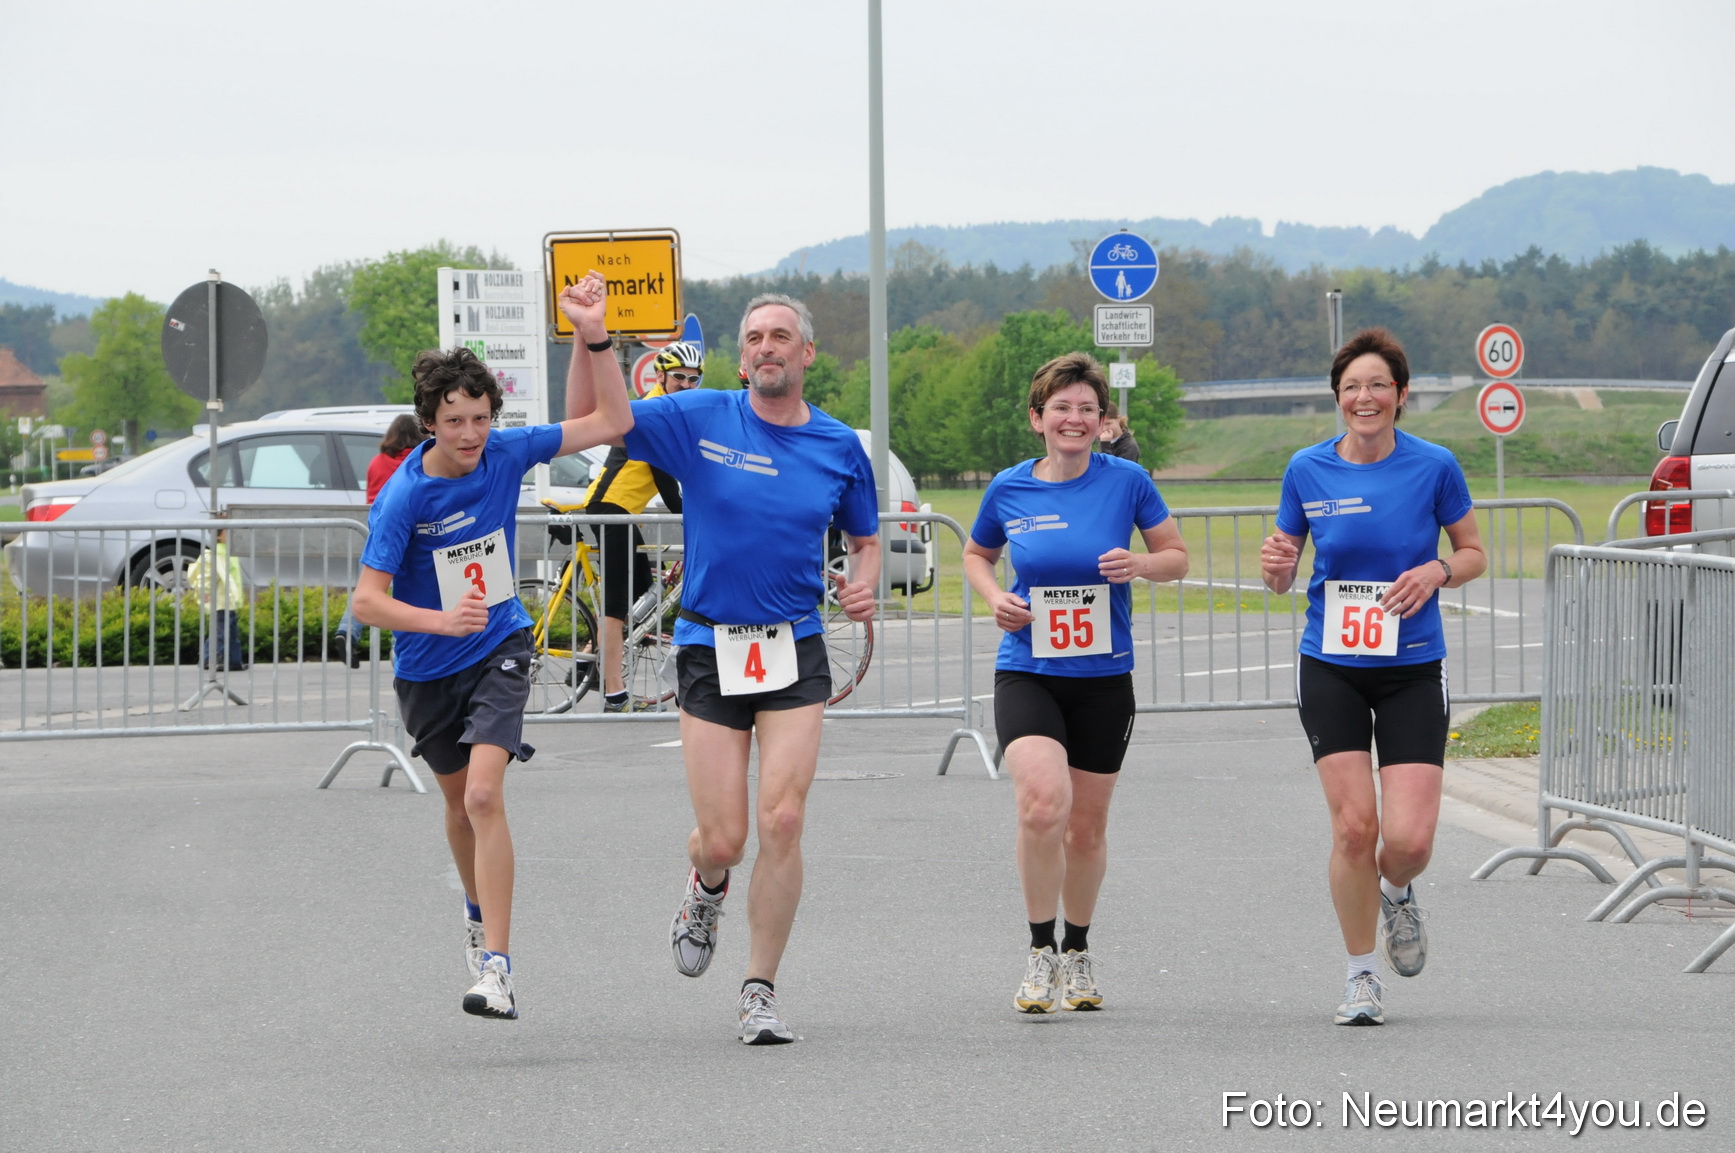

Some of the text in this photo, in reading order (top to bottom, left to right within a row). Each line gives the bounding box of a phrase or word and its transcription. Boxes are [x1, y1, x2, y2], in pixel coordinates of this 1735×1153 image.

[597, 254, 631, 265] Nach
[484, 273, 523, 287] HOLZAMMER
[565, 272, 664, 296] Nmarkt
[485, 305, 524, 319] HOLZAMMER
[617, 306, 635, 317] km
[1105, 310, 1142, 320] Landwirt-
[1101, 321, 1147, 330] schaftlicher
[1101, 331, 1148, 341] Verkehr frei
[486, 343, 525, 360] Holzfachmarkt
[1489, 340, 1513, 362] 60
[447, 542, 482, 559] MEYER
[448, 551, 484, 565] WERBUNG
[464, 562, 487, 601] 3
[1338, 584, 1373, 593] MEYER
[1043, 589, 1079, 598] MEYER
[728, 624, 763, 636] MEYER
[1049, 608, 1094, 650] 55
[1341, 606, 1384, 649] 56
[728, 633, 765, 642] WERBUNG
[744, 642, 766, 683] 4
